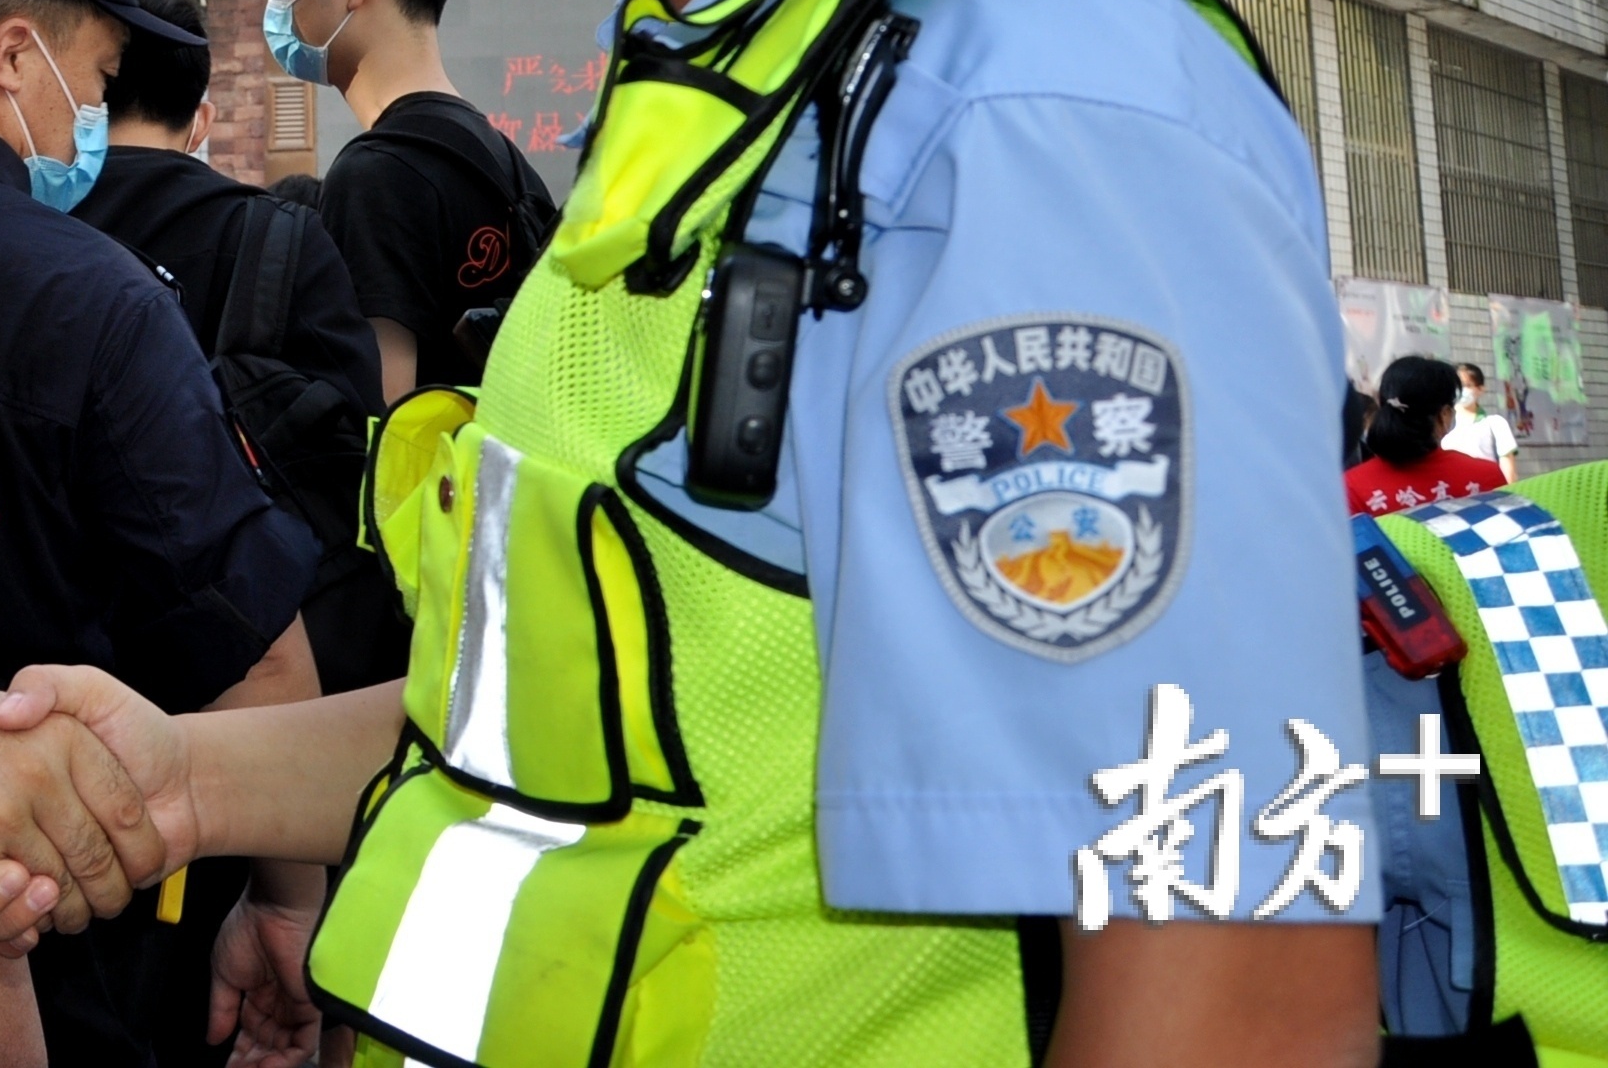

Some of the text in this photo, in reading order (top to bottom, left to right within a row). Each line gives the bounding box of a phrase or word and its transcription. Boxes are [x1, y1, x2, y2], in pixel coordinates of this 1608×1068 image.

[904, 325, 1168, 414] 中华人民共和国
[993, 468, 1108, 505] POLICE
[1363, 557, 1416, 619] POLICE
